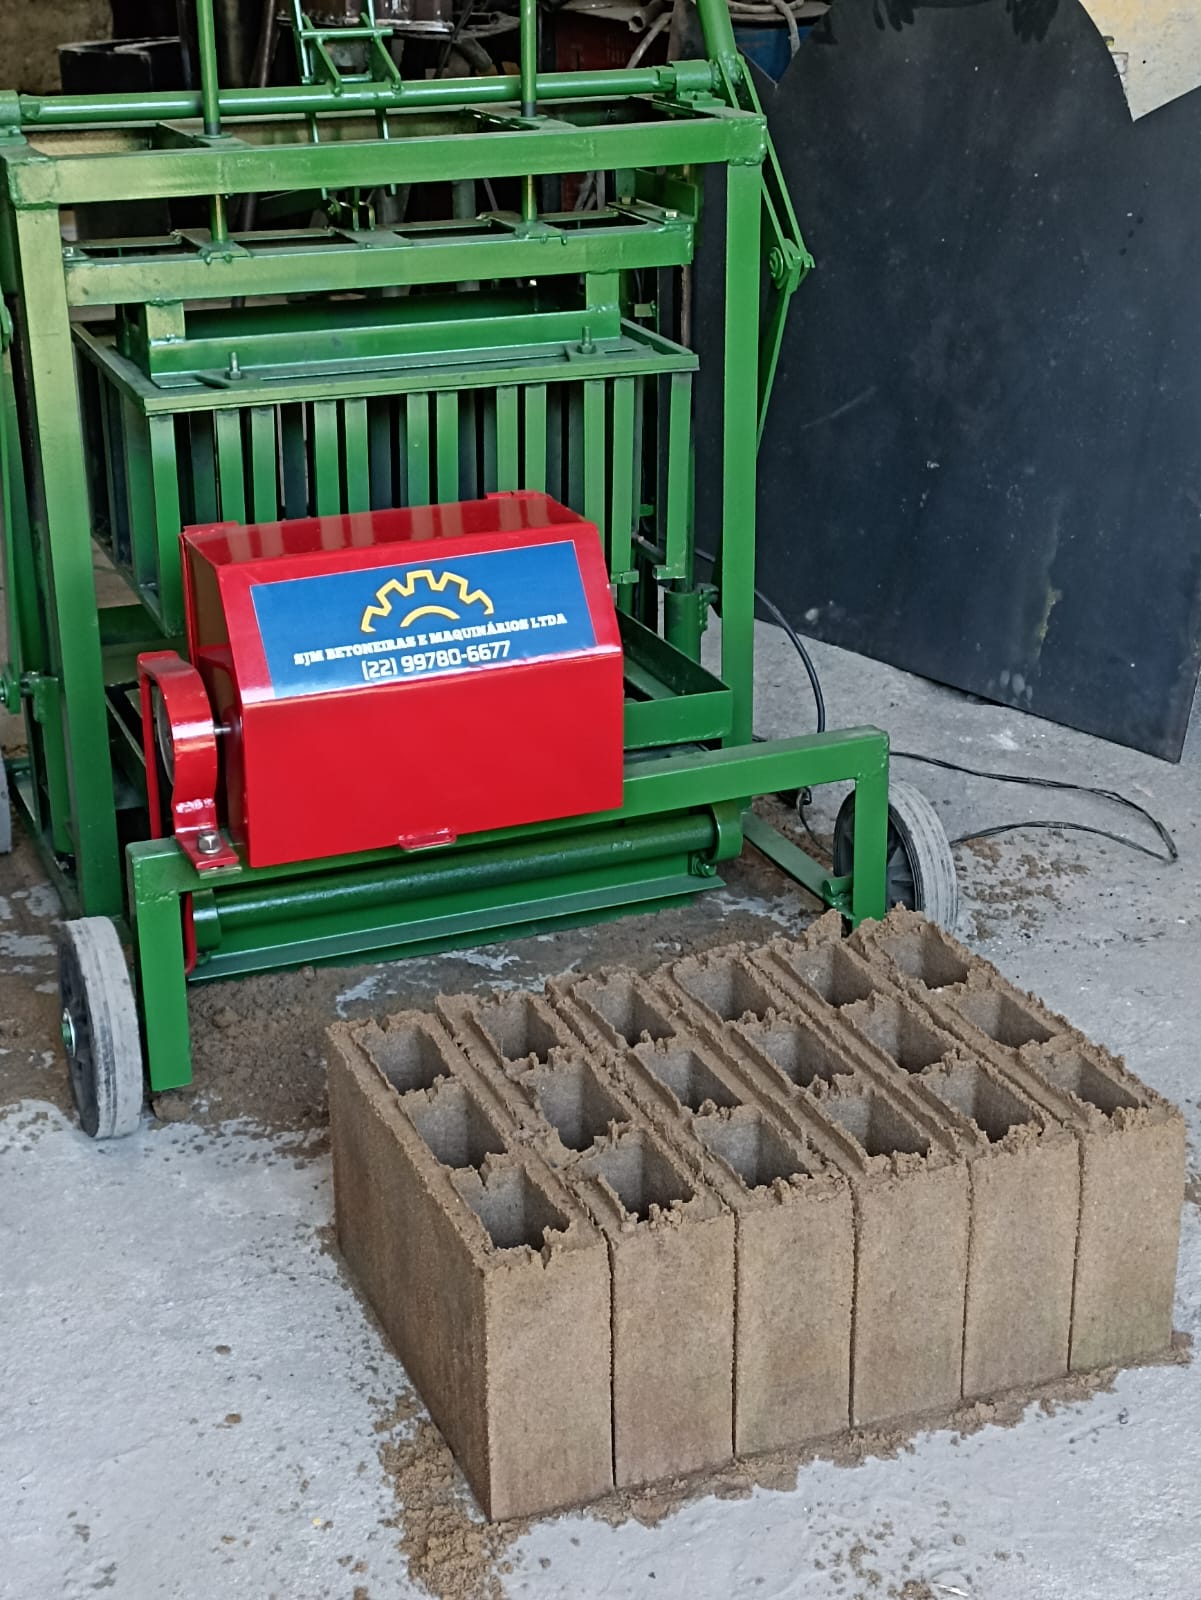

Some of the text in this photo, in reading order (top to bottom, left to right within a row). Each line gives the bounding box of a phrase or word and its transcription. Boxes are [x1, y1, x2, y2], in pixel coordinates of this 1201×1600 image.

[293, 613, 568, 667] SJM BETONEIRAS E MAQUINÁRIOS LTDA
[361, 640, 511, 681] (22) 99780-6677
